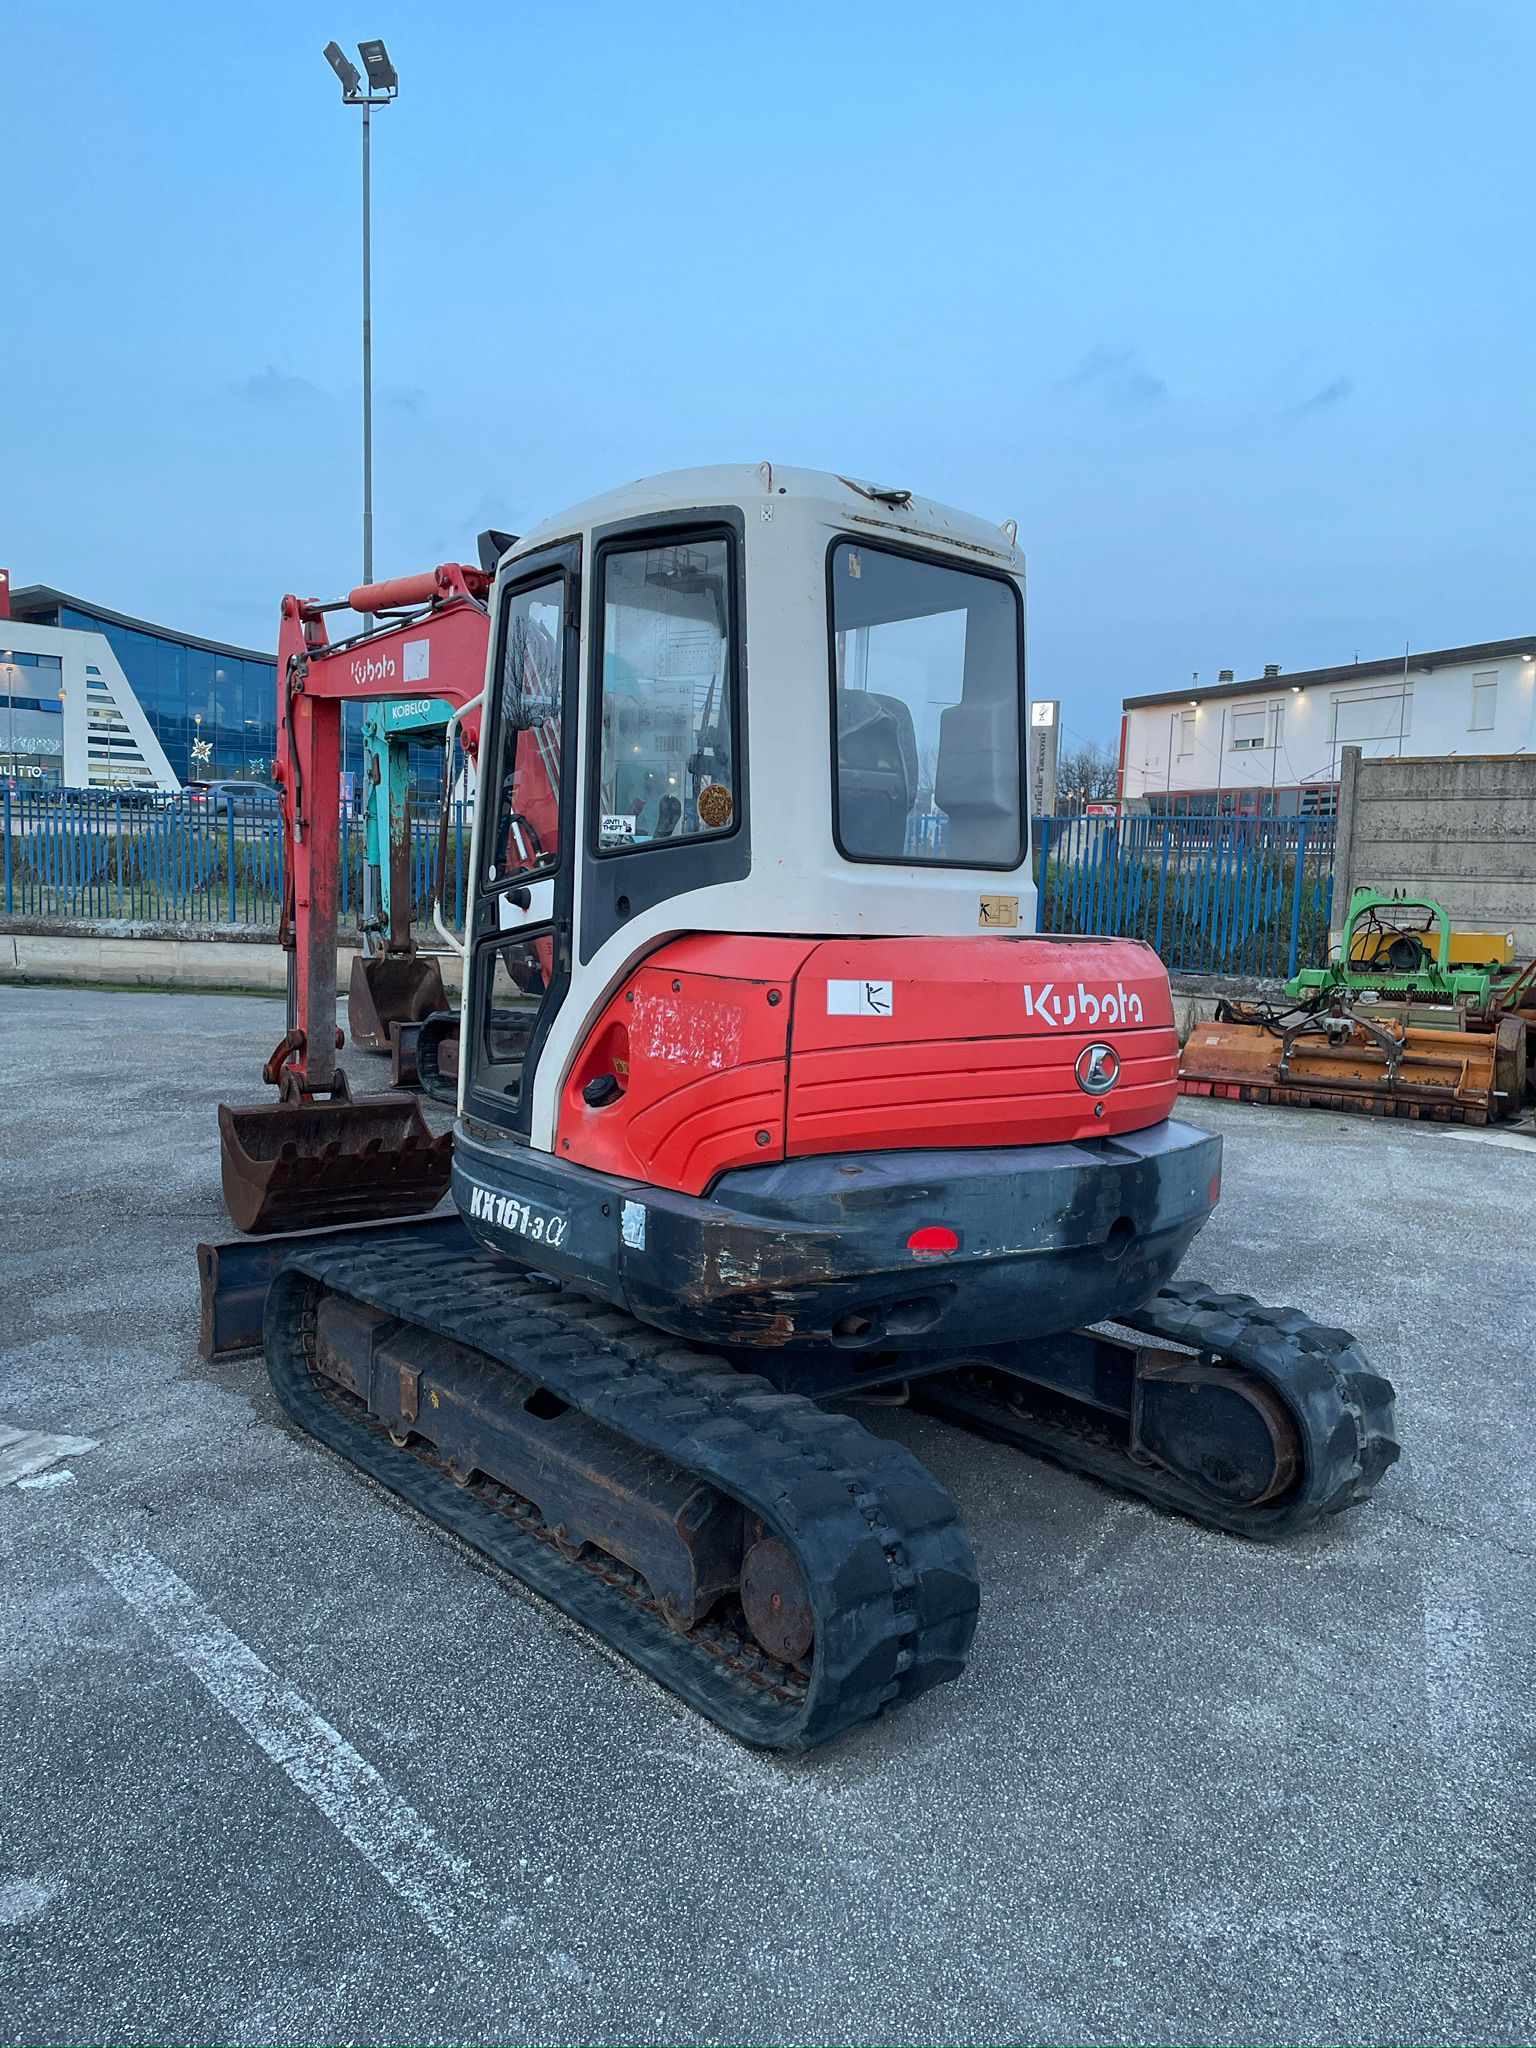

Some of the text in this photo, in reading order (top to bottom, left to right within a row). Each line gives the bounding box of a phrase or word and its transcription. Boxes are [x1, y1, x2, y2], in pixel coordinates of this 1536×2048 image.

[351, 654, 395, 684] Kubota
[392, 700, 431, 719] KOBELCO
[1023, 982, 1144, 1026] Kubota
